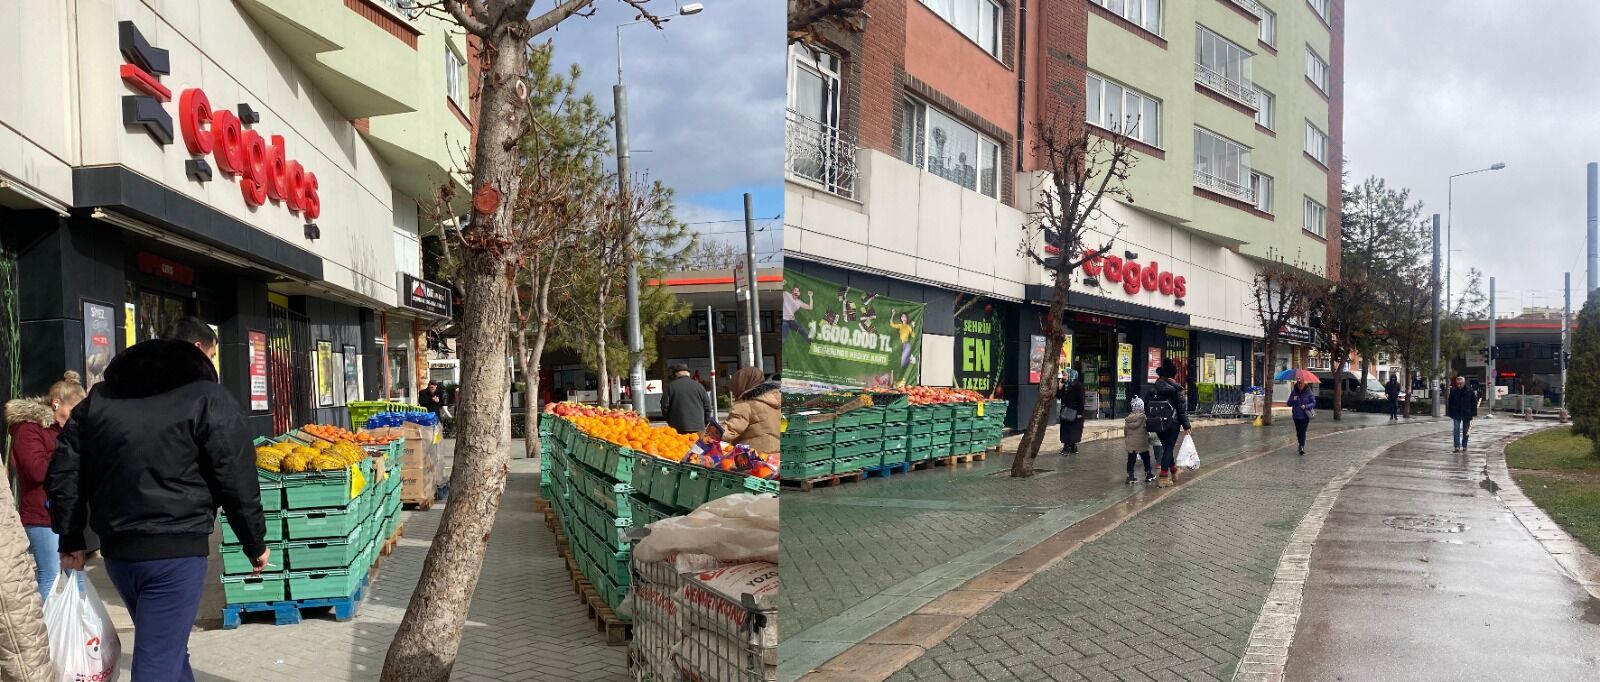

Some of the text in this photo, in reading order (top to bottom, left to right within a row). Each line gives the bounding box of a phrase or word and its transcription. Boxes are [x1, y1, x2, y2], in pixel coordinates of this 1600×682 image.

[807, 319, 893, 353] 1.600.000 TL
[963, 318, 991, 335] ŞEHRİN
[963, 337, 991, 372] EN
[962, 373, 990, 391] TAZESİ
